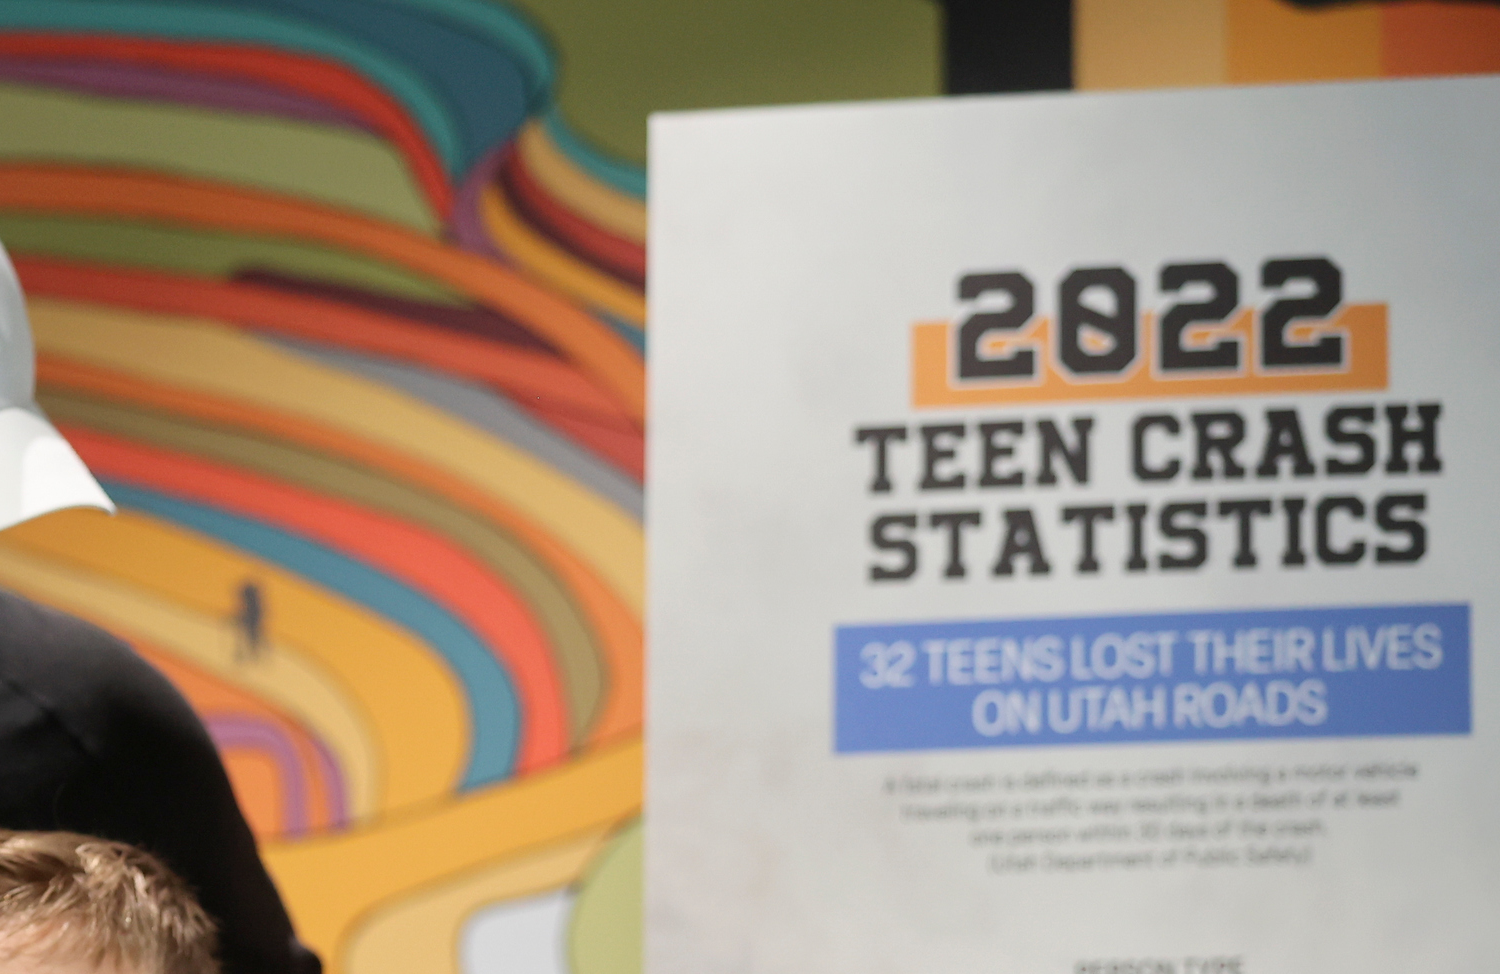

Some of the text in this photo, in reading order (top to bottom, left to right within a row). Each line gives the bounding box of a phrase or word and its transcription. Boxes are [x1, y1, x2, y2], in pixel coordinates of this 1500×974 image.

[954, 256, 1347, 384] 2022
[854, 402, 1444, 494] TEEN CRASH
[867, 493, 1429, 583] STATISTICS
[858, 622, 1443, 689] 32 TEENS LOST THEIR LIVES
[972, 679, 1329, 737] ON UTAH ROADS
